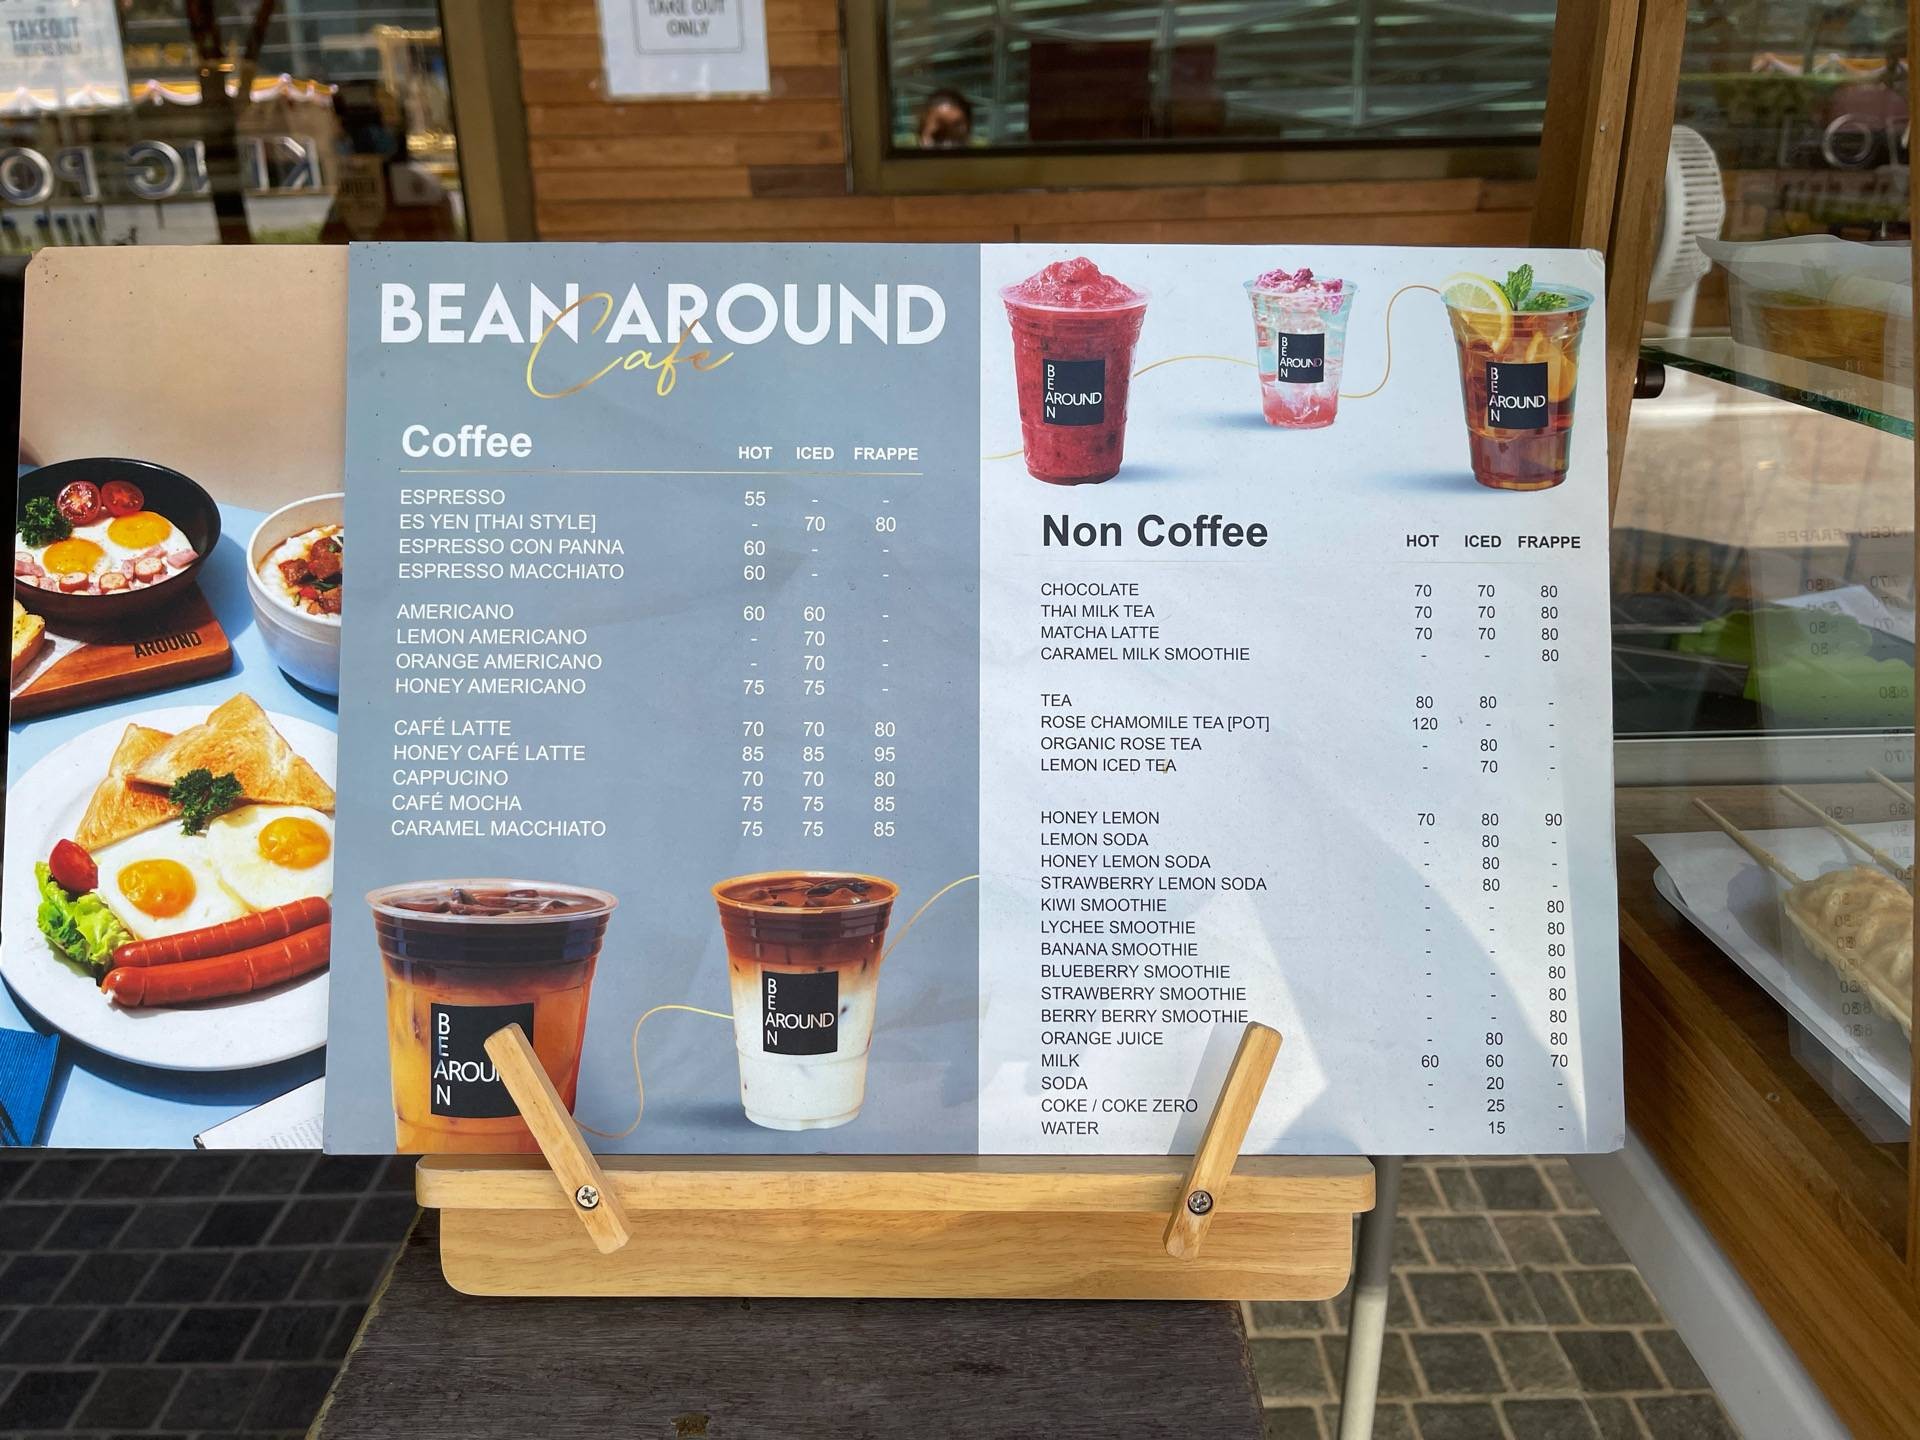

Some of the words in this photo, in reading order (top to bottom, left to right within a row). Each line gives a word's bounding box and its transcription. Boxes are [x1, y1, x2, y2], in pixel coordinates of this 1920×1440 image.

[667, 20, 711, 38] ONLY
[380, 283, 577, 343] BEAN
[604, 283, 947, 345] AROUND
[1280, 357, 1323, 368] AROUND
[1045, 391, 1102, 405] AROUND
[1489, 393, 1546, 409] AROUND
[402, 424, 533, 458] Coffee
[739, 446, 772, 459] HOT
[797, 447, 834, 459] ICED
[854, 447, 918, 460] FRAPPE
[400, 488, 506, 505] ESPRESSO
[744, 490, 766, 507] 55
[399, 513, 425, 530] ES
[429, 513, 469, 530] YEN
[475, 513, 524, 534] [THAI
[529, 513, 596, 534] STYLE]
[875, 516, 897, 533] 80
[1042, 514, 1123, 547] Non
[1137, 514, 1269, 547] Coffee
[399, 538, 505, 555] ESPRESSO
[509, 538, 553, 555] CON
[558, 538, 625, 555] PANNA
[743, 539, 766, 556] 60
[1407, 535, 1439, 547] HOT
[1465, 535, 1501, 548] ICED
[1518, 536, 1581, 549] FRAPPE
[398, 562, 504, 580] ESPRESSO
[509, 563, 625, 580] MACCHIATO
[1040, 582, 1140, 597] CHOCOLATE
[1414, 583, 1433, 598] 70
[1477, 584, 1496, 598] 70
[396, 603, 514, 620] AMERICANO
[743, 605, 765, 622] 60
[803, 605, 826, 622] 60
[1039, 604, 1077, 618] THAI
[1081, 604, 1120, 618] MILK
[1122, 604, 1156, 618] TEA
[1414, 605, 1433, 620] 70
[1477, 605, 1496, 619] 70
[396, 628, 465, 645] LEMON
[468, 628, 588, 645] AMERICANO
[1040, 625, 1108, 640] MATCHA
[1111, 625, 1160, 640] LATTE
[1414, 626, 1433, 641] 70
[1477, 626, 1496, 641] 70
[134, 631, 202, 658] AROUND
[395, 652, 480, 670] ORANGE
[483, 653, 603, 670] AMERICANO
[803, 655, 825, 671] 70
[1040, 646, 1119, 661] CARAMEL
[1122, 647, 1161, 661] MILK
[1164, 646, 1251, 661] SMOOTHIE
[1541, 648, 1560, 663] 80
[395, 677, 465, 694] HONEY
[467, 677, 586, 695] AMERICANO
[743, 679, 765, 696] 75
[1039, 693, 1073, 708] TEA
[1415, 695, 1434, 709] 80
[394, 716, 446, 736] CAFÉ
[451, 719, 512, 736] LATTE
[742, 720, 765, 737] 70
[803, 721, 825, 737] 70
[1040, 714, 1087, 730] ROSE
[1090, 714, 1189, 730] CHAMOMILE
[1191, 715, 1225, 730] TEA
[1227, 715, 1270, 734] [POT]
[1412, 716, 1439, 731] 120
[393, 744, 463, 761] HONEY
[467, 741, 520, 761] CAFÉ
[525, 744, 586, 761] LATTE
[742, 745, 764, 762] 85
[802, 745, 825, 762] 85
[1040, 736, 1116, 751] ORGANIC
[1120, 736, 1166, 751] ROSE
[1169, 736, 1203, 751] TEA
[1479, 738, 1498, 752] 80
[1040, 757, 1098, 773] LEMON
[1102, 757, 1141, 773] ICED
[1144, 758, 1177, 773] TEA
[392, 769, 509, 786] CAPPUCINO
[741, 770, 764, 787] 70
[802, 770, 824, 787] 70
[391, 791, 444, 811] CAFÉ
[449, 794, 523, 812] MOCHA
[741, 795, 764, 812] 75
[802, 795, 824, 812] 75
[1040, 810, 1099, 825] HONEY
[1102, 810, 1160, 825] LEMON
[1416, 812, 1436, 827] 70
[1481, 812, 1500, 827] 80
[391, 819, 486, 837] CARAMEL
[490, 819, 607, 837] MACCHIATO
[741, 820, 763, 837] 75
[802, 821, 824, 837] 75
[1040, 831, 1098, 847] LEMON
[1102, 832, 1150, 847] SODA
[1481, 834, 1500, 848] 80
[1040, 853, 1099, 869] HONEY
[1102, 854, 1160, 869] LEMON
[1164, 854, 1212, 869] SODA
[1481, 856, 1500, 870] 80
[1040, 875, 1155, 891] STRAWBERRY
[1158, 876, 1216, 891] LEMON
[1220, 876, 1268, 891] SODA
[1040, 897, 1076, 912] KIWI
[1080, 897, 1168, 913] SMOOTHIE
[1546, 899, 1565, 914] 80
[1040, 919, 1105, 935] LYCHEE
[1108, 919, 1196, 935] SMOOTHIE
[1547, 921, 1566, 936] 80
[1040, 941, 1109, 957] BANANA
[1111, 942, 1199, 957] SMOOTHIE
[1040, 963, 1140, 979] BLUEBERRY
[1143, 964, 1231, 979] SMOOTHIE
[1547, 965, 1566, 980] 80
[1040, 985, 1156, 1001] STRAWBERRY
[1159, 986, 1247, 1001] SMOOTHIE
[1548, 987, 1567, 1002] 80
[765, 1012, 835, 1029] AROUND
[1041, 1008, 1098, 1024] BERRY
[1101, 1008, 1158, 1024] BERRY
[1161, 1008, 1249, 1024] SMOOTHIE
[1040, 1030, 1113, 1046] ORANGE
[1116, 1030, 1165, 1046] JUICE
[1485, 1031, 1504, 1046] 80
[1549, 1031, 1568, 1046] 80
[1041, 1053, 1080, 1068] MILK
[1485, 1053, 1504, 1068] 60
[1550, 1053, 1569, 1068] 70
[434, 1060, 500, 1082] AROU
[1040, 1075, 1089, 1091] SODA
[1040, 1098, 1088, 1113] COKE
[1101, 1098, 1148, 1113] COKE
[1152, 1098, 1199, 1113] ZERO
[1486, 1098, 1506, 1113] 25
[1040, 1120, 1100, 1136] WATER
[1488, 1120, 1506, 1135] 15
